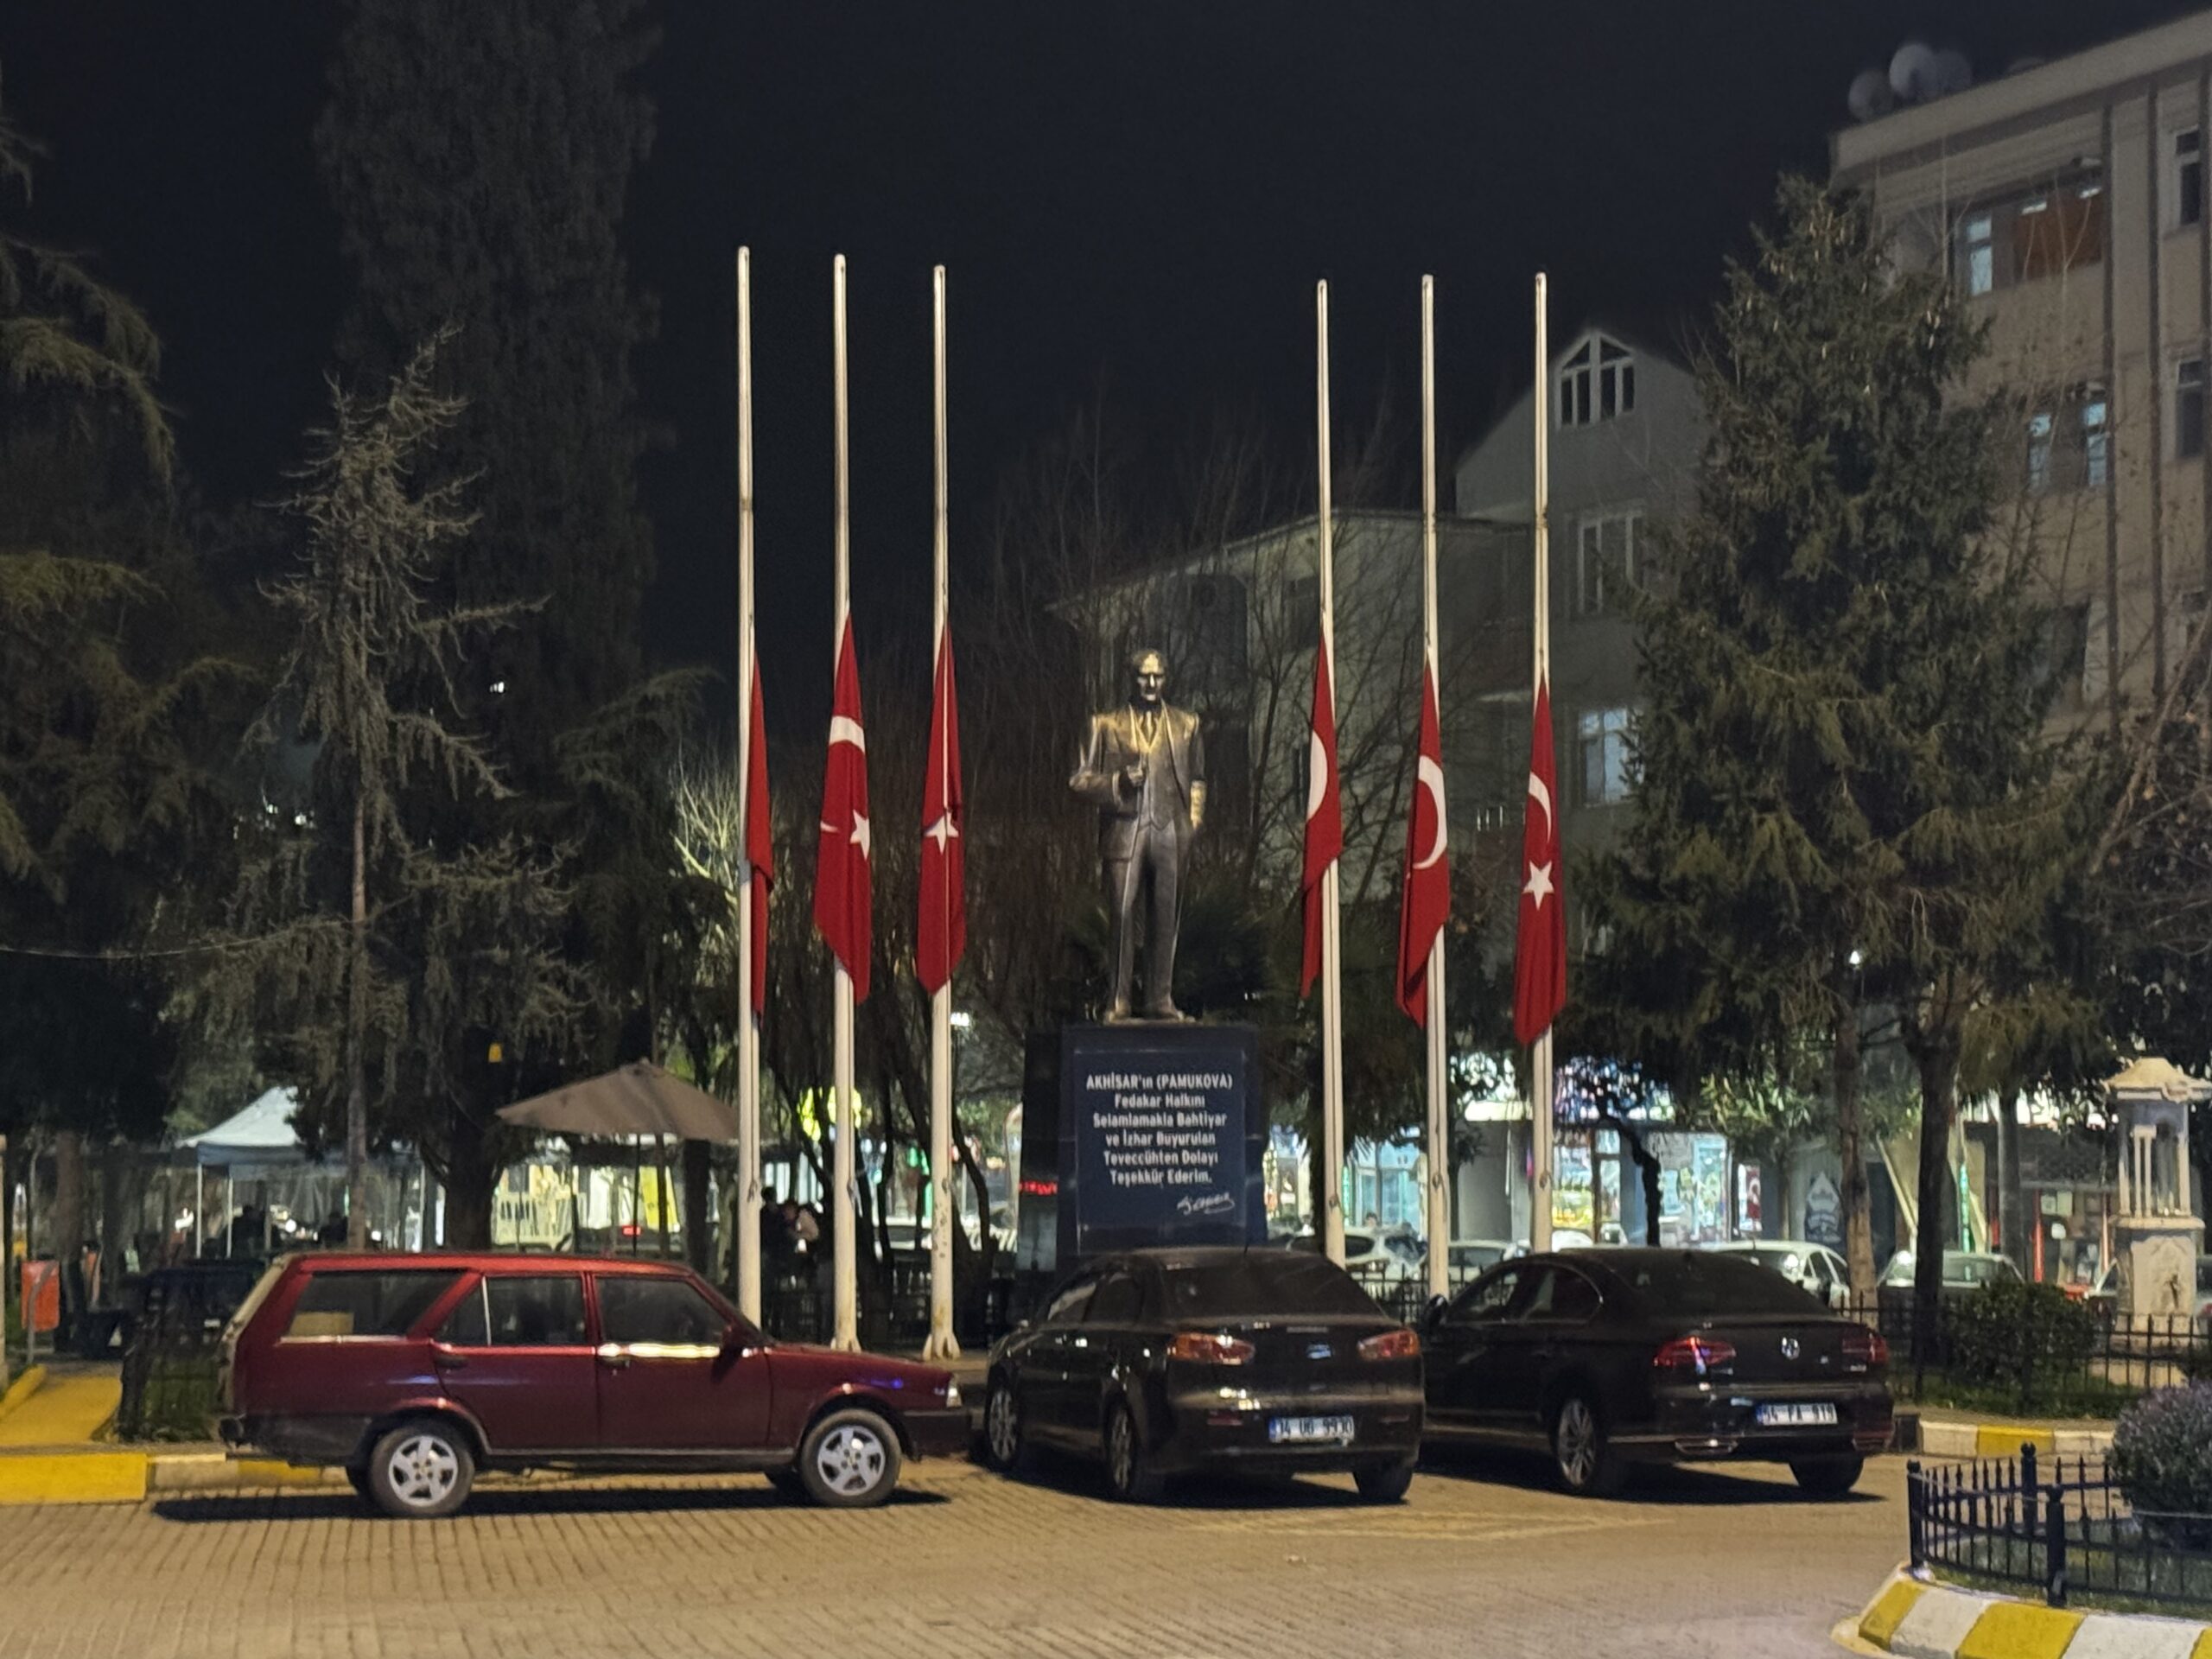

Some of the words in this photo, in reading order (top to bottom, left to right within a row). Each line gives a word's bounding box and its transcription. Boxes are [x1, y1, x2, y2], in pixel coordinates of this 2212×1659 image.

[1156, 1072, 1233, 1090] (PAMUKOVA)
[1115, 1093, 1162, 1109] Fedakar
[1165, 1093, 1205, 1108] Halkını
[1093, 1111, 1174, 1128] Selamlamakla
[1176, 1110, 1228, 1129] Bahtiyar
[1105, 1134, 1120, 1147] ve
[1156, 1131, 1216, 1148] Buyurulan
[1103, 1150, 1179, 1166] Teveccühten
[1181, 1150, 1218, 1166] Dolayı
[1109, 1168, 1164, 1188] Teşekkür
[1167, 1168, 1213, 1184] Ederim.
